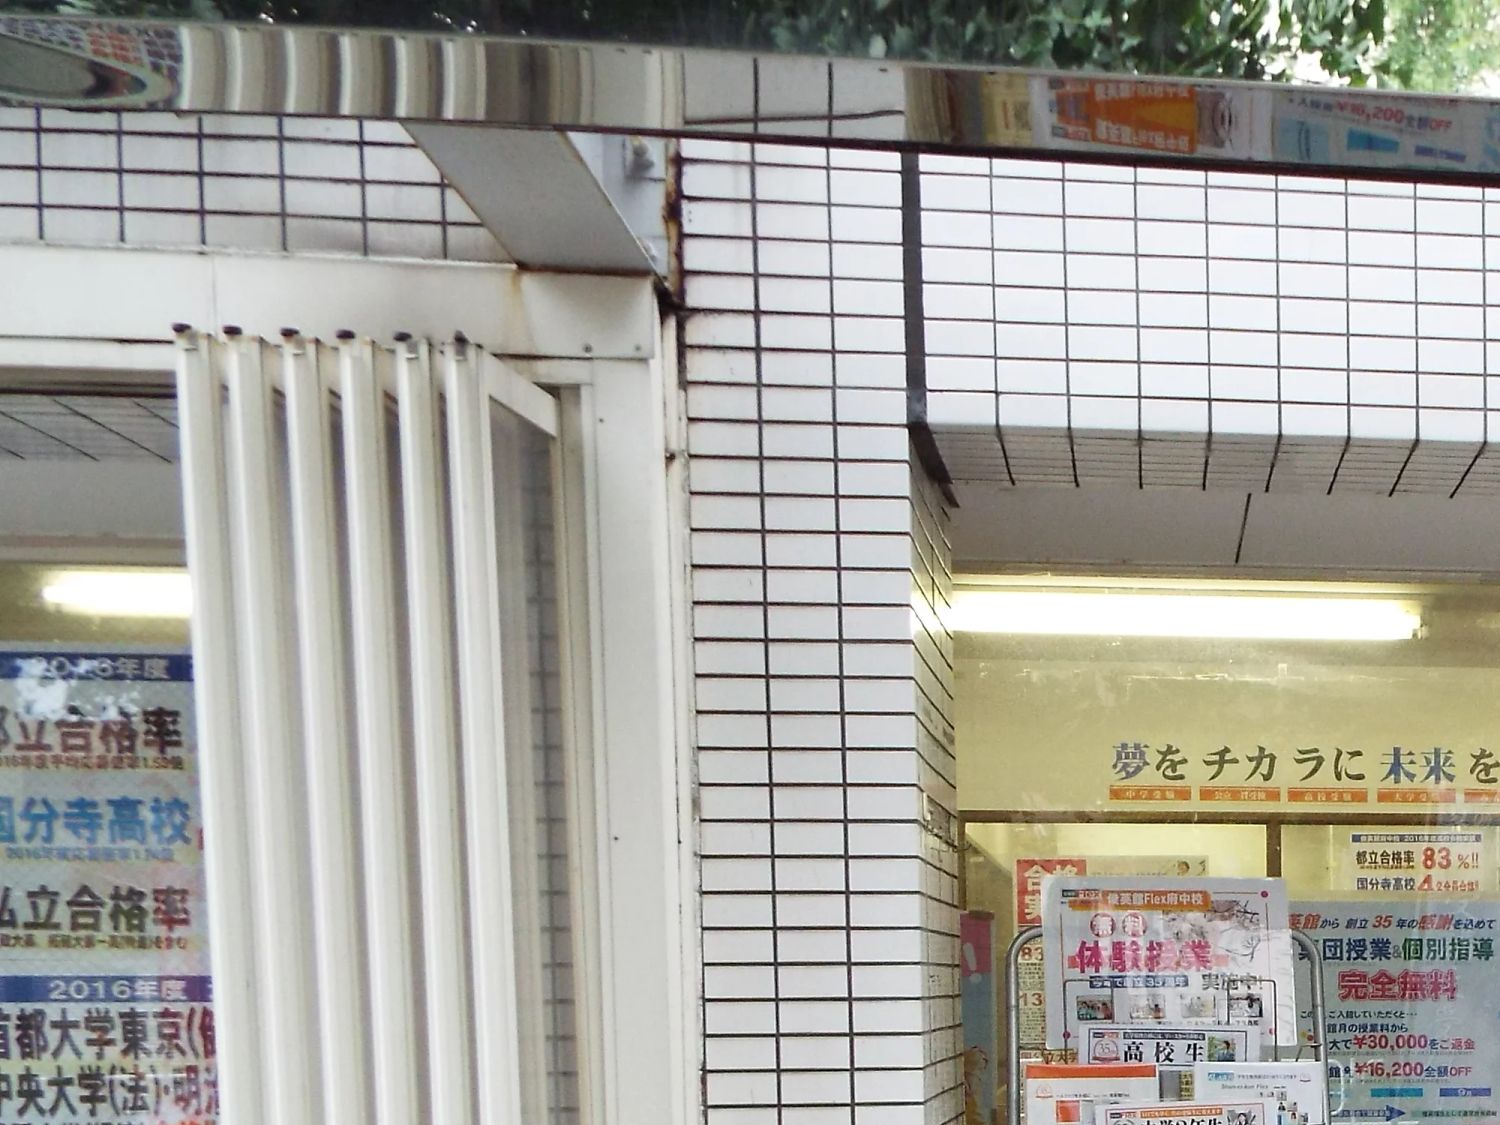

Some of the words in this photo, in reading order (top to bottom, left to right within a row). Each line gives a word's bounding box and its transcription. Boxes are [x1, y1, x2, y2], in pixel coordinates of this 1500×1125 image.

[1356, 850, 1415, 866] 都立合格率
[1357, 877, 1416, 892] 国分寺高校
[1074, 939, 1212, 974] 体験授業
[50, 979, 187, 1000] 2016年度
[1338, 968, 1457, 1002] 完全無料
[1123, 1041, 1206, 1064] 高校生
